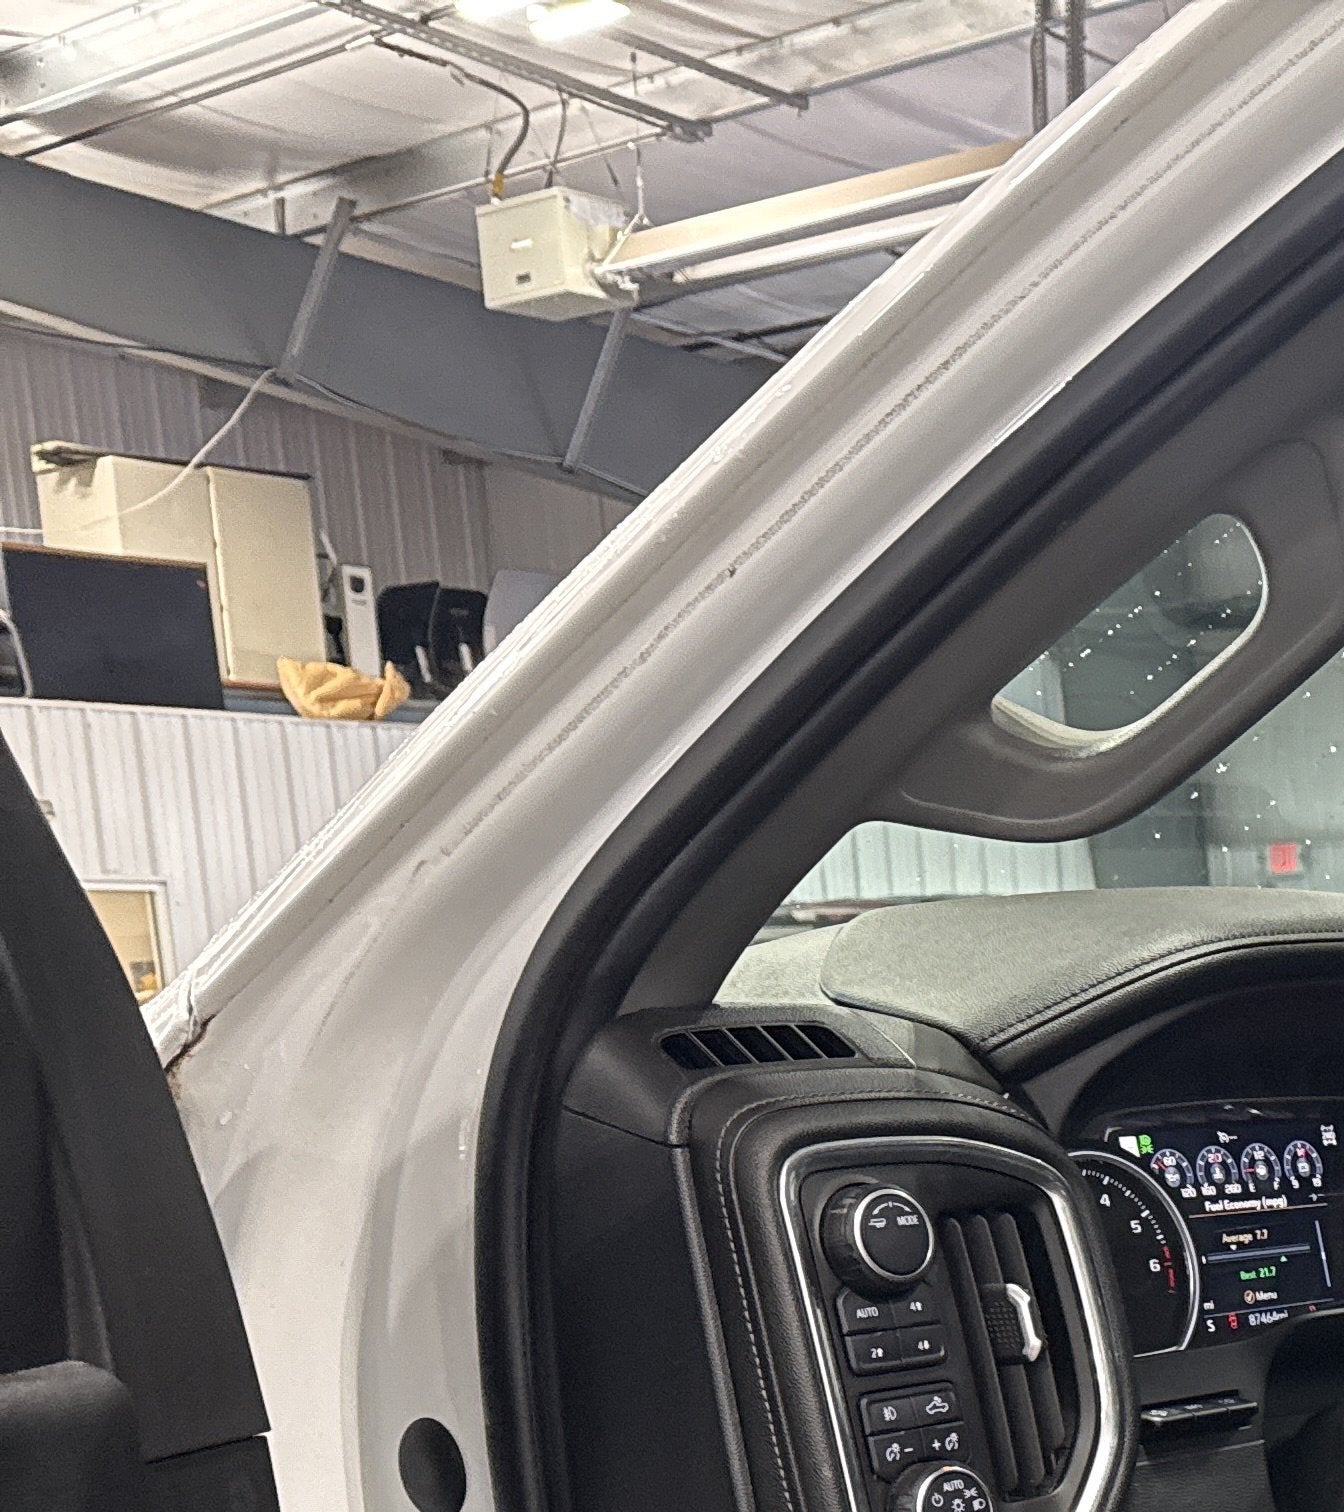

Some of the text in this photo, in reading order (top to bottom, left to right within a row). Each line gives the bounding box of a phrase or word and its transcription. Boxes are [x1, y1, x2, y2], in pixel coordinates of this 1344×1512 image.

[1100, 1194, 1111, 1207] 4
[1204, 1194, 1288, 1212] Fuel Economy (mpg)
[896, 1215, 919, 1226] MODE
[1130, 1220, 1142, 1233] 5
[1222, 1231, 1253, 1244] Average
[1149, 1259, 1160, 1272] 6
[1255, 1290, 1278, 1301] Menu
[856, 1306, 879, 1319] AUTO
[1206, 1319, 1216, 1332] S
[943, 1479, 965, 1492] AUTO
